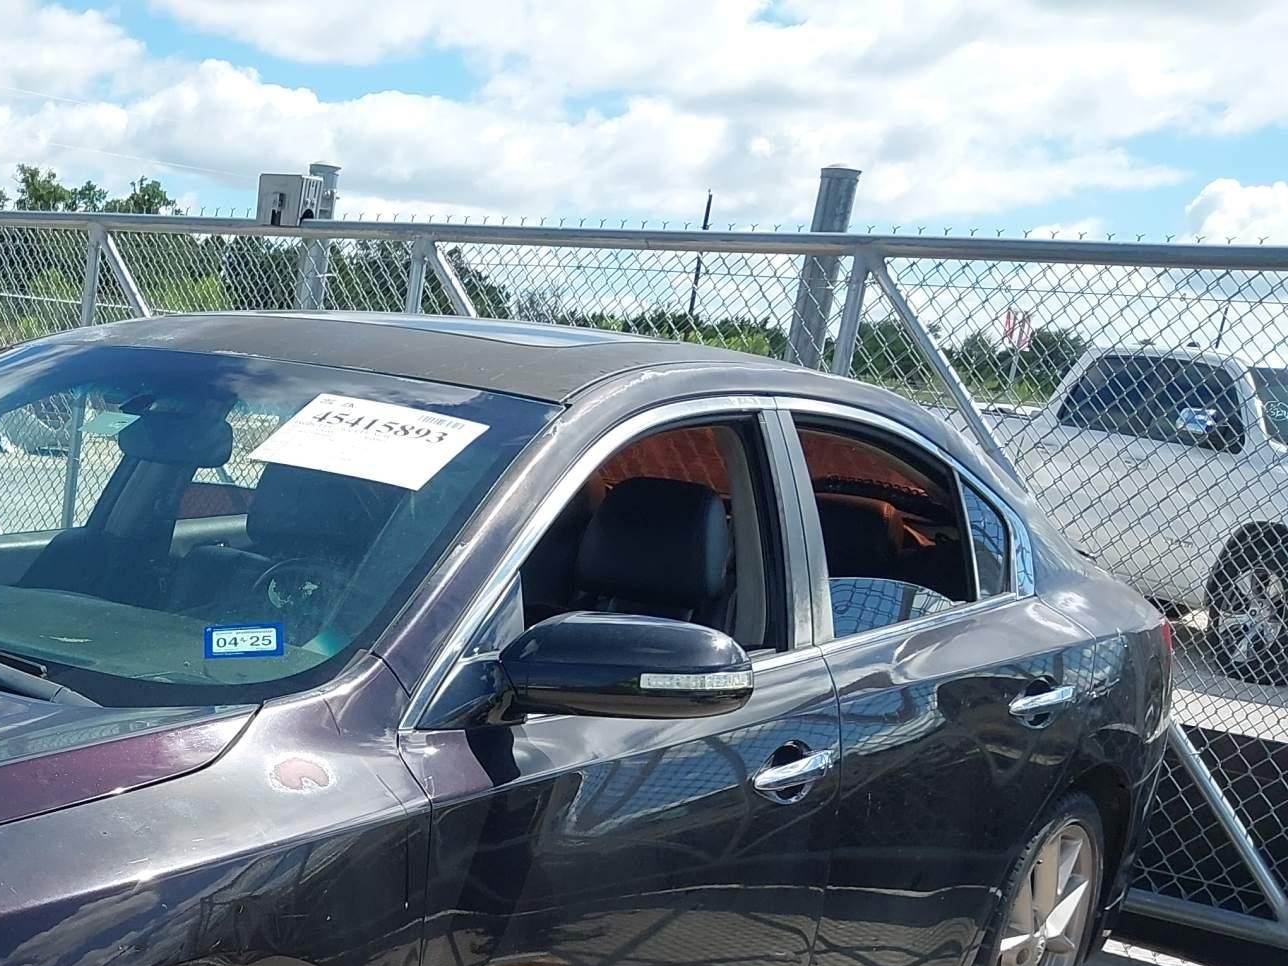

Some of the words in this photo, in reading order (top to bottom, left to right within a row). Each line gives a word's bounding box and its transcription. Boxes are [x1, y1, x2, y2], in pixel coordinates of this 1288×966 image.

[312, 410, 448, 444] 45415893
[216, 636, 239, 648] 04
[249, 635, 272, 647] 25
